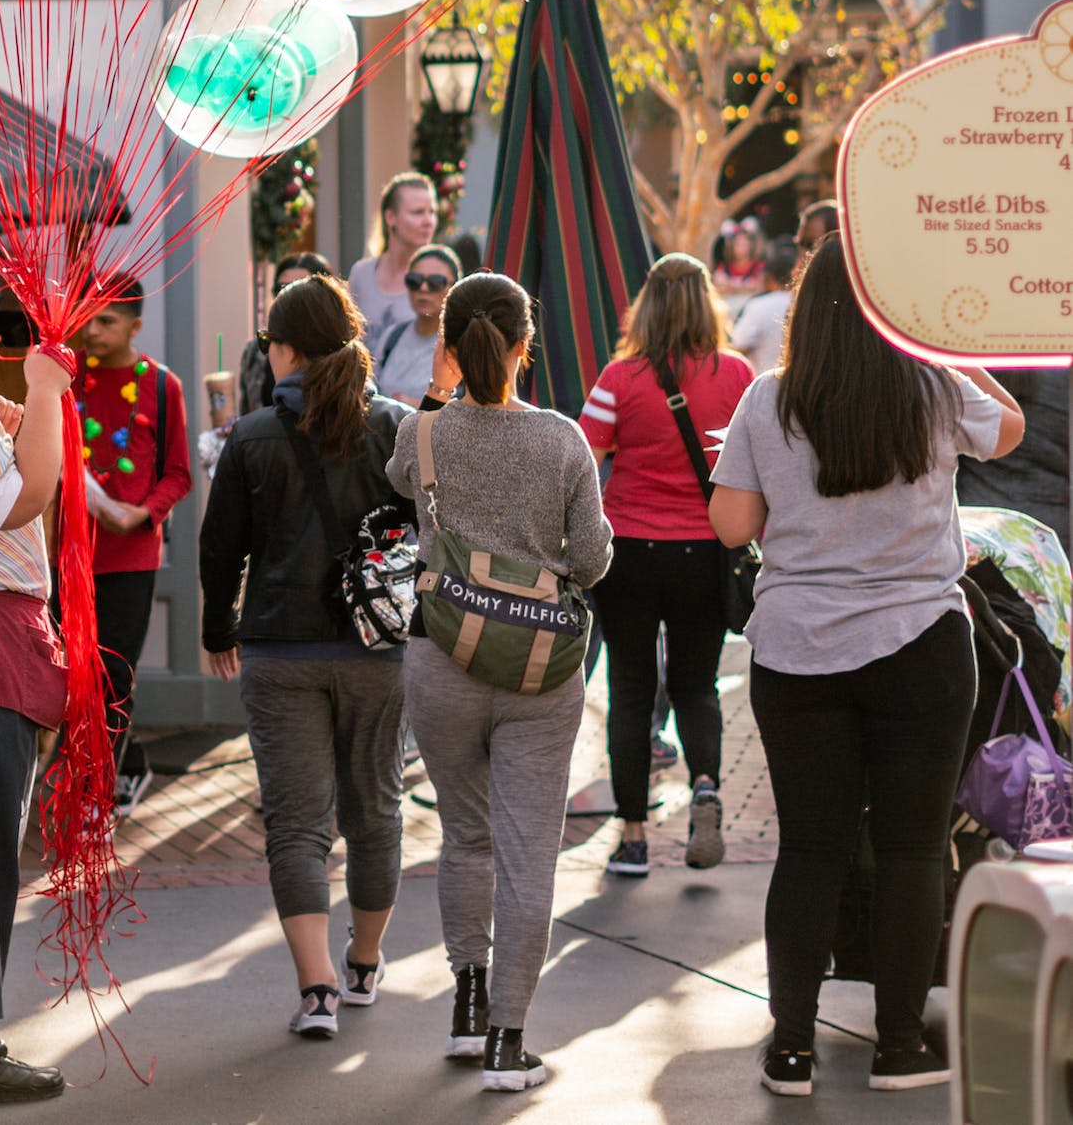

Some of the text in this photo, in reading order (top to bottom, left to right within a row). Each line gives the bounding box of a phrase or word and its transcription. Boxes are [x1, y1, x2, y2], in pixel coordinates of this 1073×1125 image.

[993, 106, 1059, 123] Frozen
[943, 136, 956, 145] or
[960, 128, 1064, 149] Strawberry
[916, 194, 1047, 214] Nestlé Dibs
[924, 219, 1042, 231] Bite Sized Snacks
[966, 237, 1010, 254] 5.50
[442, 574, 502, 611] TOMMY
